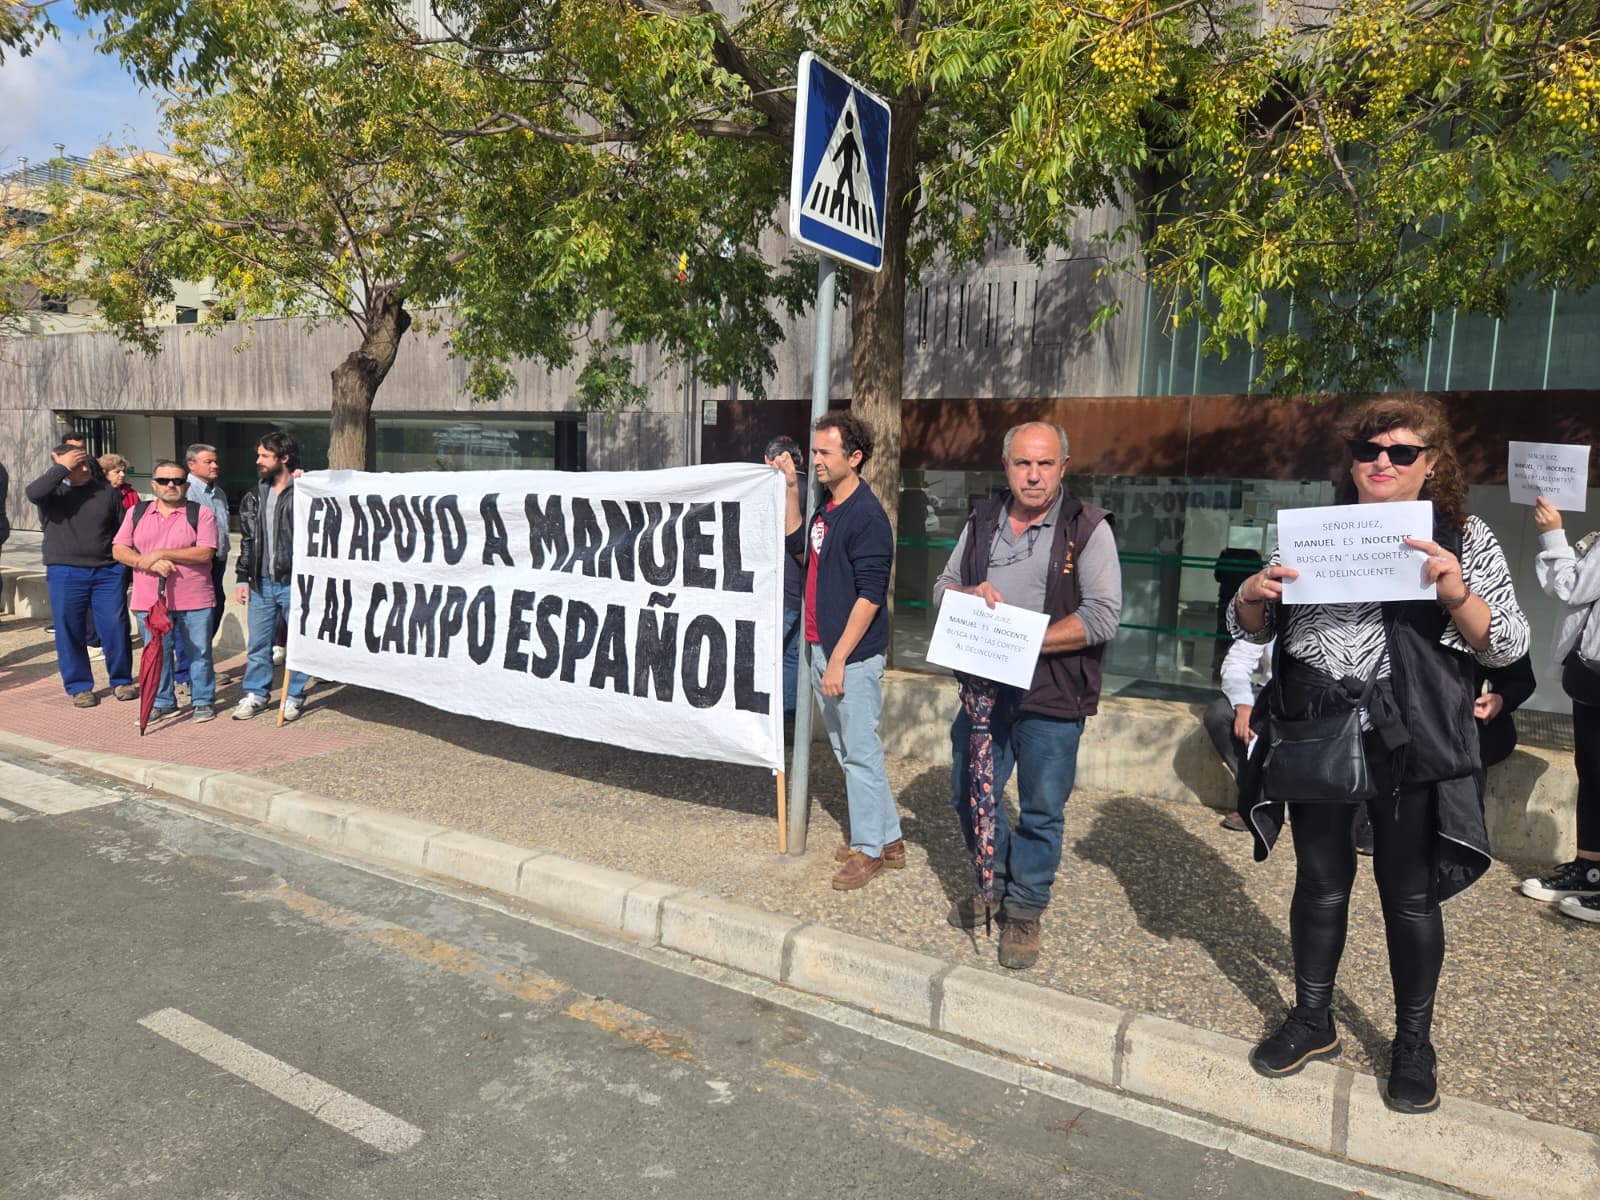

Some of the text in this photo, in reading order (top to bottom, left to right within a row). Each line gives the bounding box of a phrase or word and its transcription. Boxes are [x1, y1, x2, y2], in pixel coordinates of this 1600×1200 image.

[1322, 520, 1383, 531] SEÑOR JUEZ,
[307, 496, 342, 559] EN
[348, 494, 468, 565] APOYO
[480, 493, 515, 567] A
[524, 493, 755, 593] MANUEL
[1294, 538, 1335, 548] MANUEL
[1343, 537, 1354, 546] ES
[1296, 554, 1327, 564] BUSCA
[1329, 554, 1342, 563] EN
[1352, 552, 1369, 561] LAS
[1315, 567, 1396, 579] AL DELINCUENTE
[946, 627, 968, 639] BUSCA
[949, 615, 978, 629] MANUEL
[993, 626, 1030, 642] INOCENTE,
[297, 574, 771, 716] Y AL CAMPO ESPAÑOL
[956, 643, 1009, 663] AL DELINCUENTE
